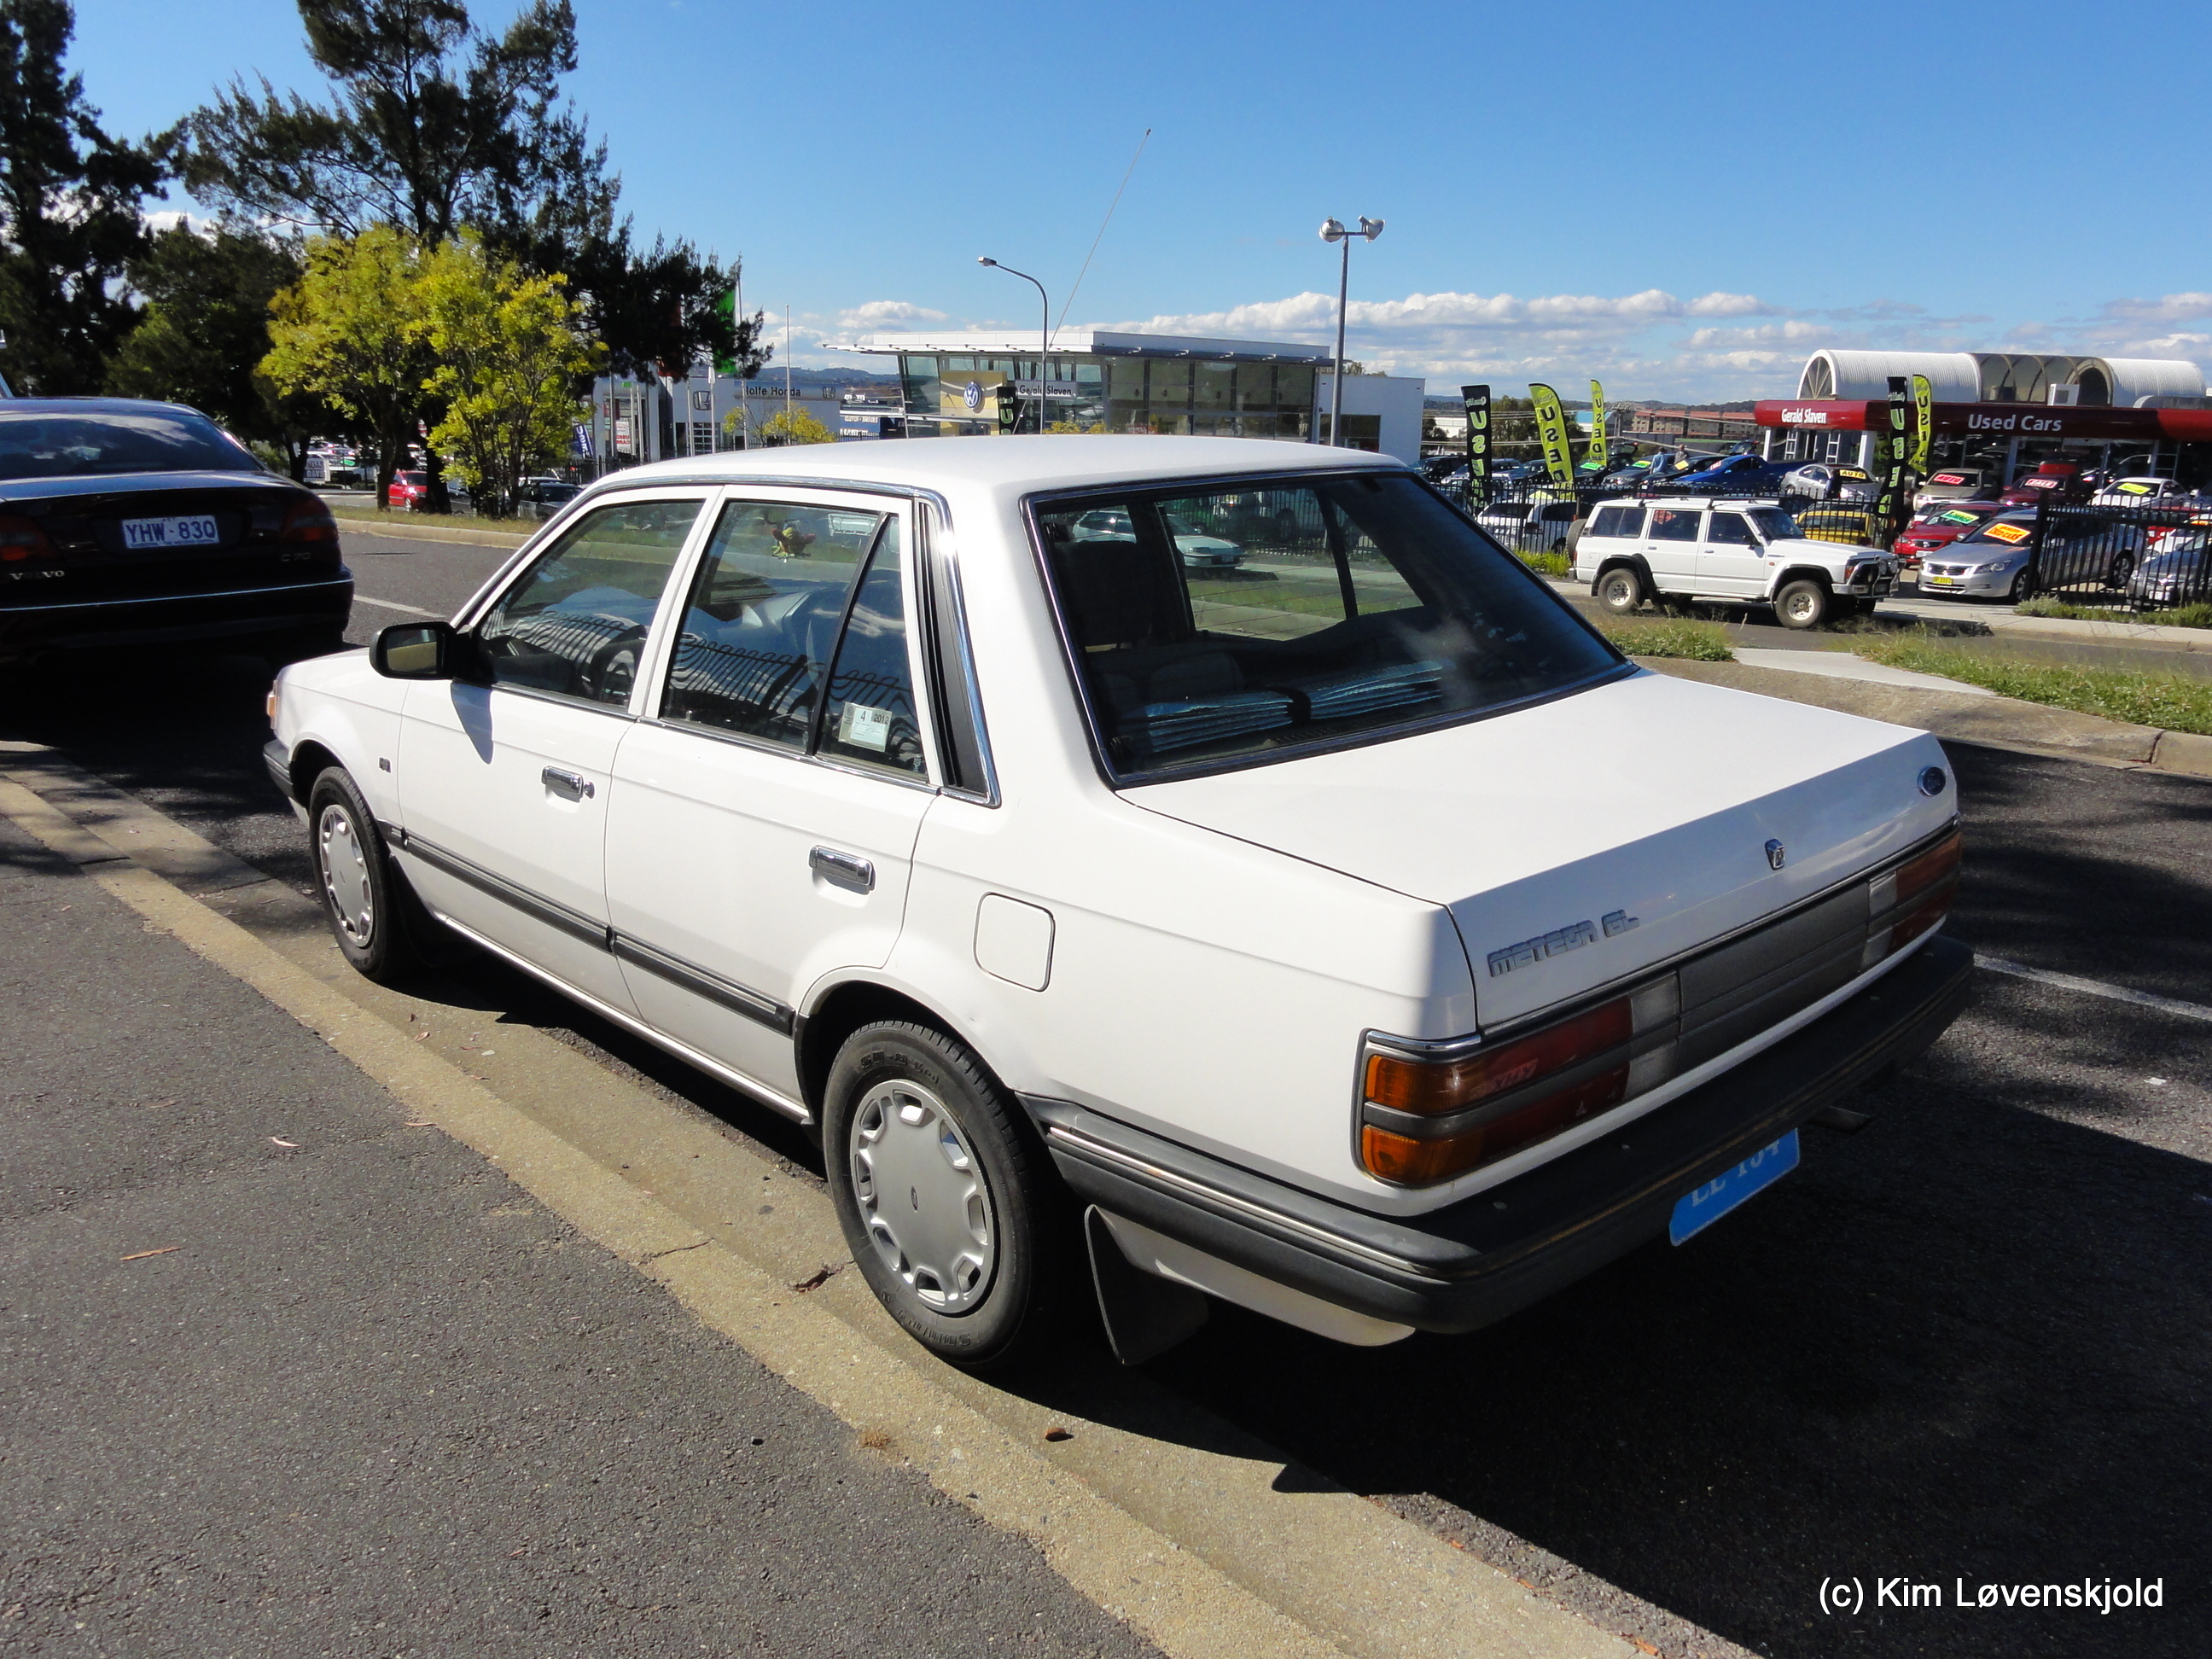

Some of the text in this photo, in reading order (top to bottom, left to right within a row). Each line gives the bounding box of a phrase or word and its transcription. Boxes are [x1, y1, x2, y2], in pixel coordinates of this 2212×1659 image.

[771, 386, 801, 396] Honda
[1046, 386, 1072, 395] Slaven
[1781, 408, 1827, 424] Gerald Slaven
[1968, 414, 2062, 432] Used Cars
[1842, 470, 1865, 479] AUTO
[9, 569, 66, 581] VOLVO
[860, 710, 867, 723] 4
[873, 713, 889, 725] 2012
[1487, 919, 1600, 978] METEOR
